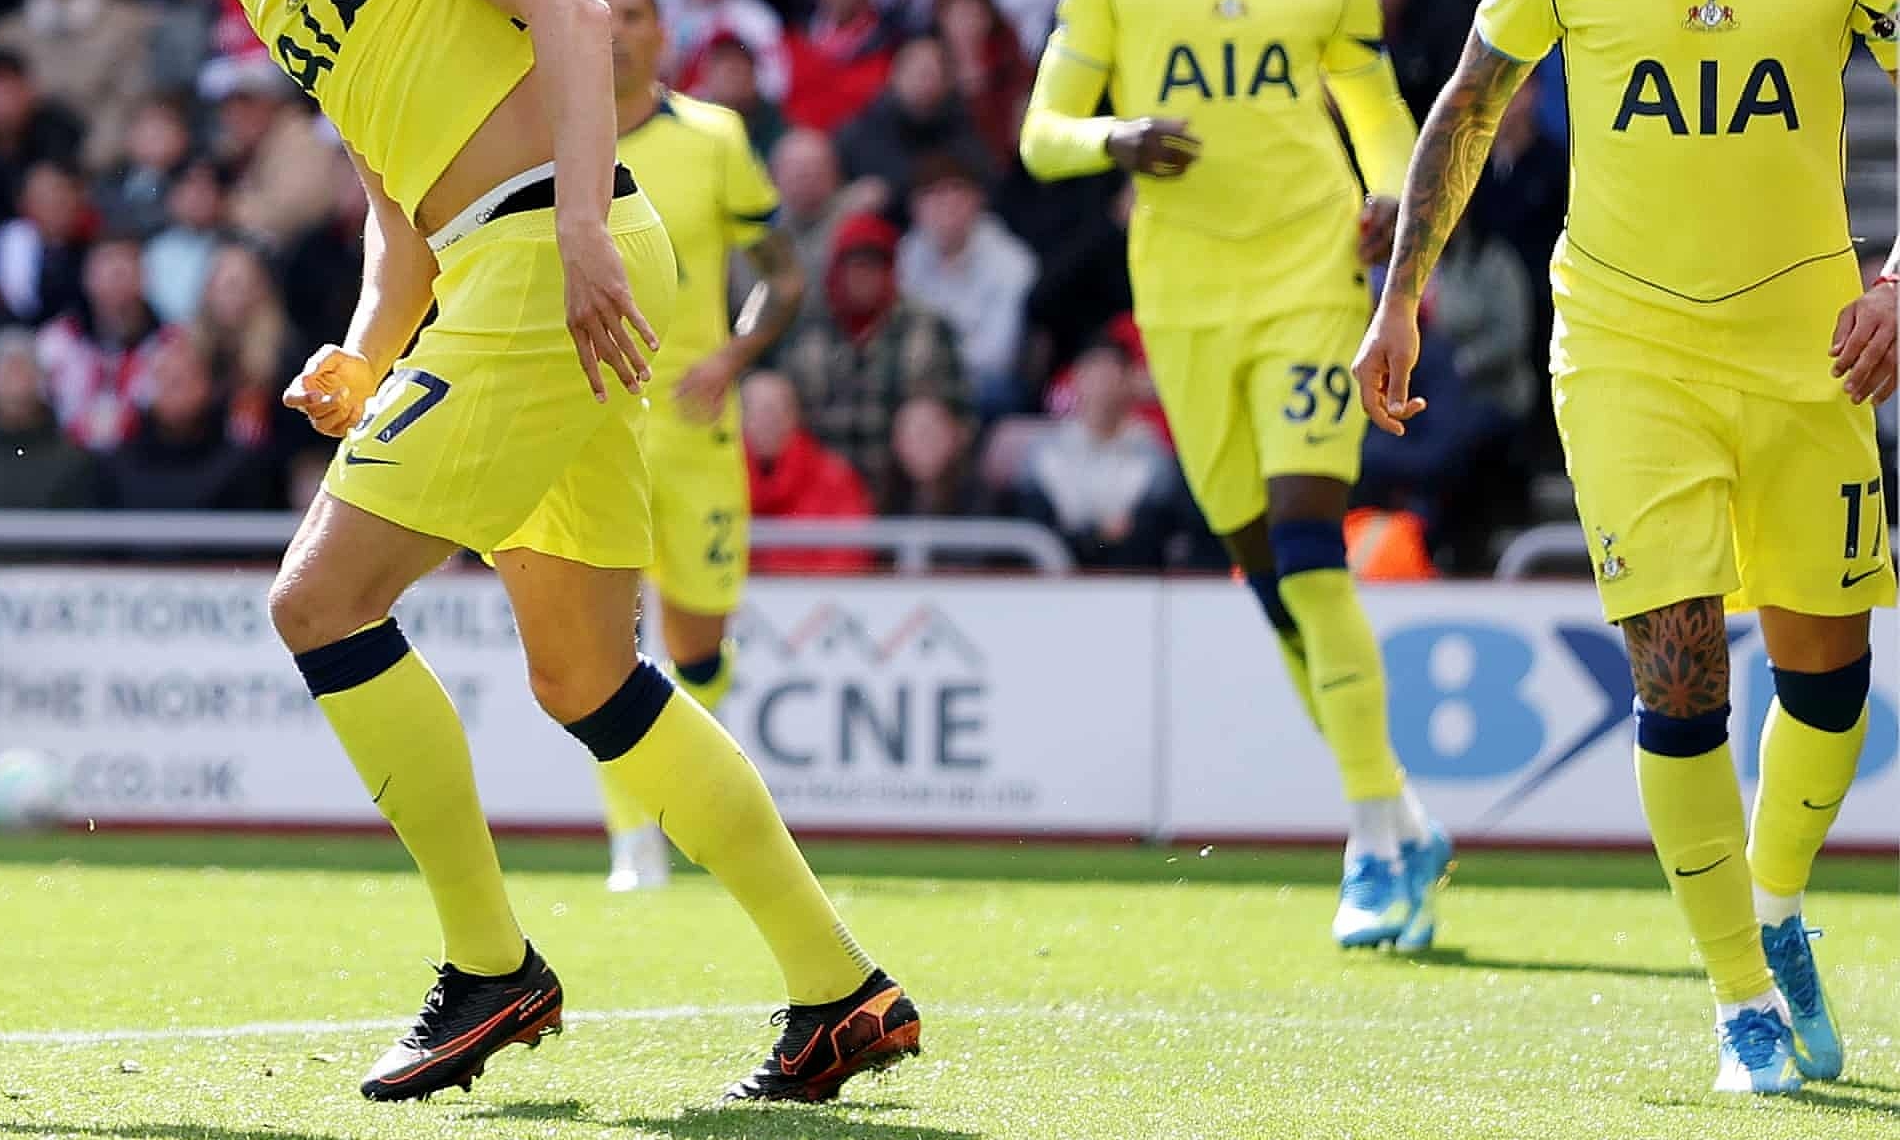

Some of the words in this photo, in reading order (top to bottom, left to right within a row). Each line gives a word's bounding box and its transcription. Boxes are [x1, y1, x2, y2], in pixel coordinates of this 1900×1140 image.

[1158, 42, 1299, 103] AIA
[1611, 58, 1800, 135] AIA
[1283, 363, 1351, 423] 39
[732, 675, 988, 766] CNE
